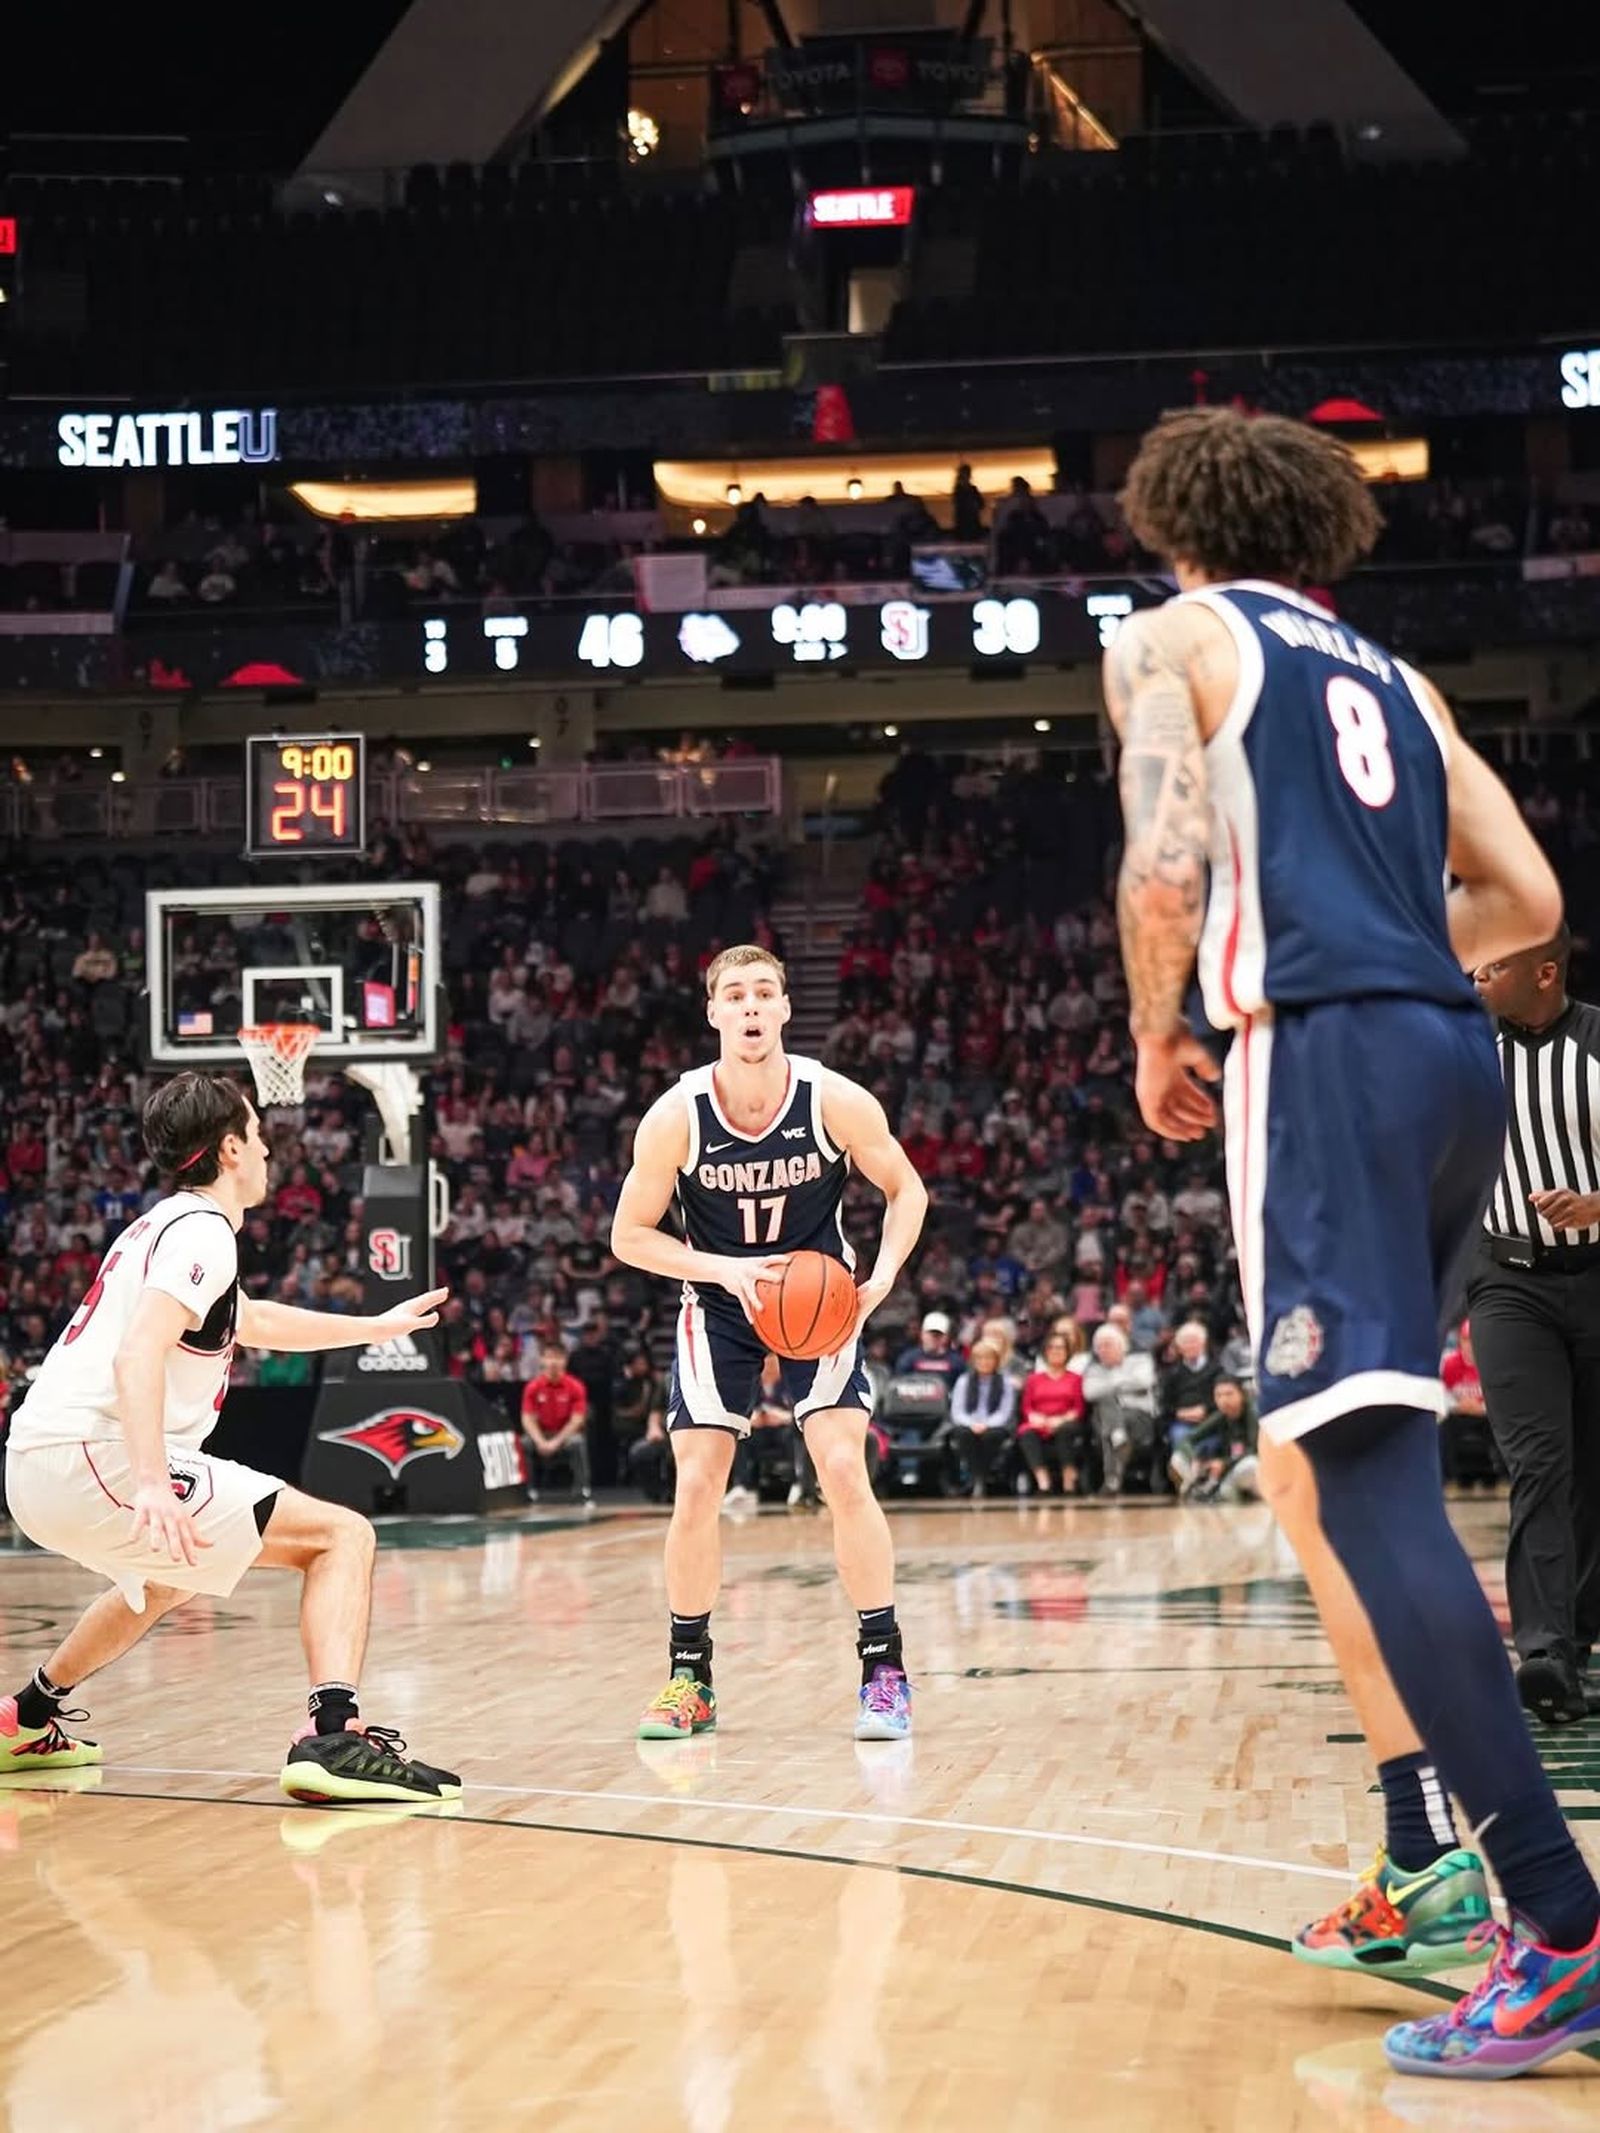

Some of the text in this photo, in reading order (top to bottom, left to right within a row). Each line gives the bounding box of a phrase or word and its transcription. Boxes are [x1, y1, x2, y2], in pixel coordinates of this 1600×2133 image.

[578, 612, 644, 668] 46
[281, 745, 354, 781] 9:00
[1325, 673, 1396, 811] 8
[271, 781, 345, 842] 24
[781, 1127, 806, 1140] WCC
[698, 1151, 822, 1193] GONZAGA
[737, 1194, 787, 1244] 17
[357, 1350, 428, 1372] adidas
